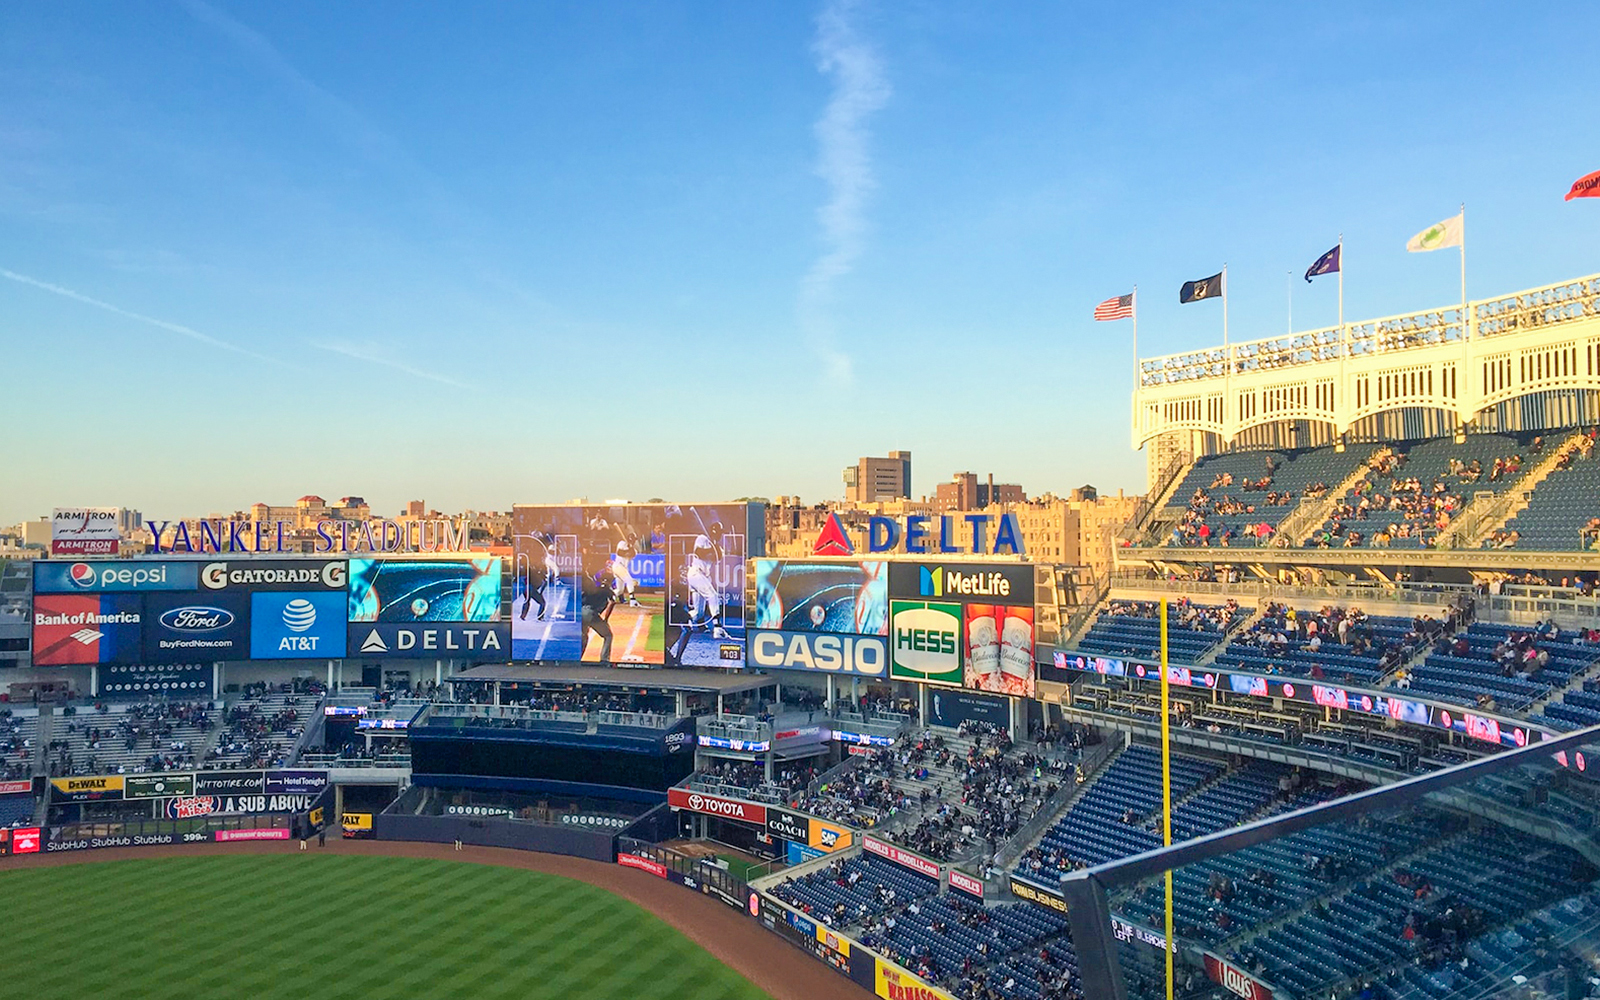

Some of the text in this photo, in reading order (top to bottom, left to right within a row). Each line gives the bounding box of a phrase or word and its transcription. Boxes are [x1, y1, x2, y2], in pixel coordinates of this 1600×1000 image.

[55, 511, 116, 521] ARMITRON
[143, 519, 472, 552] YANKEE STADIUM
[868, 513, 1026, 553] DELTA
[57, 541, 112, 549] ARMITRON
[101, 565, 166, 587] pepsi
[229, 568, 321, 584] GATORADE
[947, 571, 1011, 596] MetLife
[35, 611, 141, 626] Bank of America
[173, 608, 222, 628] Ford
[159, 639, 233, 649] BuyFordNow.com
[278, 636, 320, 651] AT&T
[397, 630, 501, 650] DELTA
[897, 627, 956, 655] HESS
[753, 632, 886, 675] CASIO
[196, 777, 263, 789] NITTOTIRE.COM
[283, 776, 326, 787] HotelTonight
[174, 796, 214, 809] Jersey
[225, 794, 312, 812] A SUB ABOVE
[704, 798, 745, 817] TOYOTA
[756, 831, 773, 845] FedEx
[769, 820, 806, 839] COACH
[821, 828, 837, 847] SAP
[47, 834, 172, 852] StubHub StubHub StubHub
[1113, 928, 1132, 944] LEFT
[1120, 922, 1133, 936] THE
[1135, 928, 1178, 954] BLEACHES
[1223, 962, 1252, 999] Lay's
